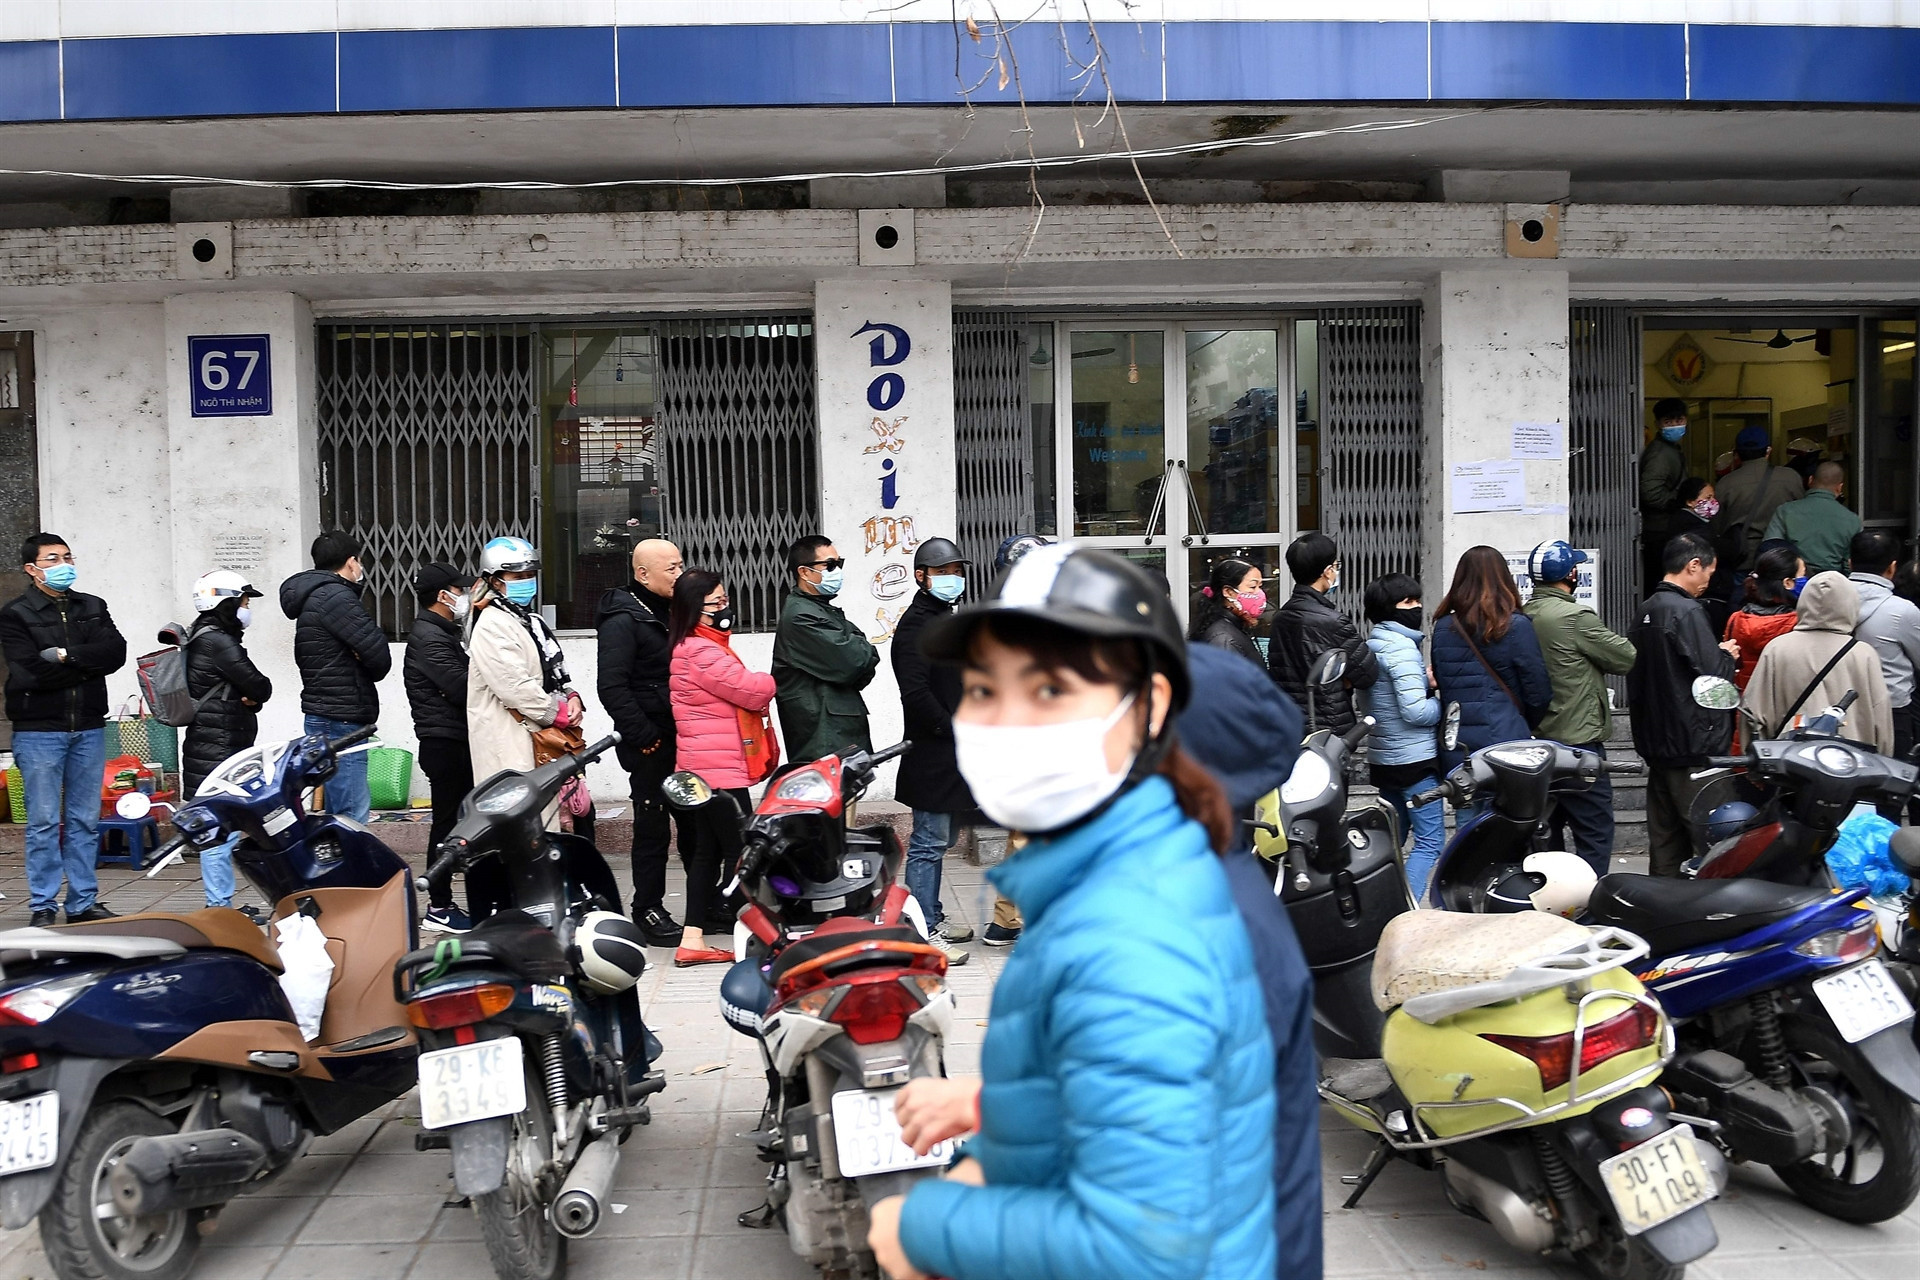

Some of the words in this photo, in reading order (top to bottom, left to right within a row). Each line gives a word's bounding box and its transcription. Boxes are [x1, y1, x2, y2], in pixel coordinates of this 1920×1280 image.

[201, 350, 260, 391] 67
[200, 397, 218, 407] NGÔ
[237, 396, 263, 407] NHẬM
[1617, 1138, 1685, 1190] 30-F1
